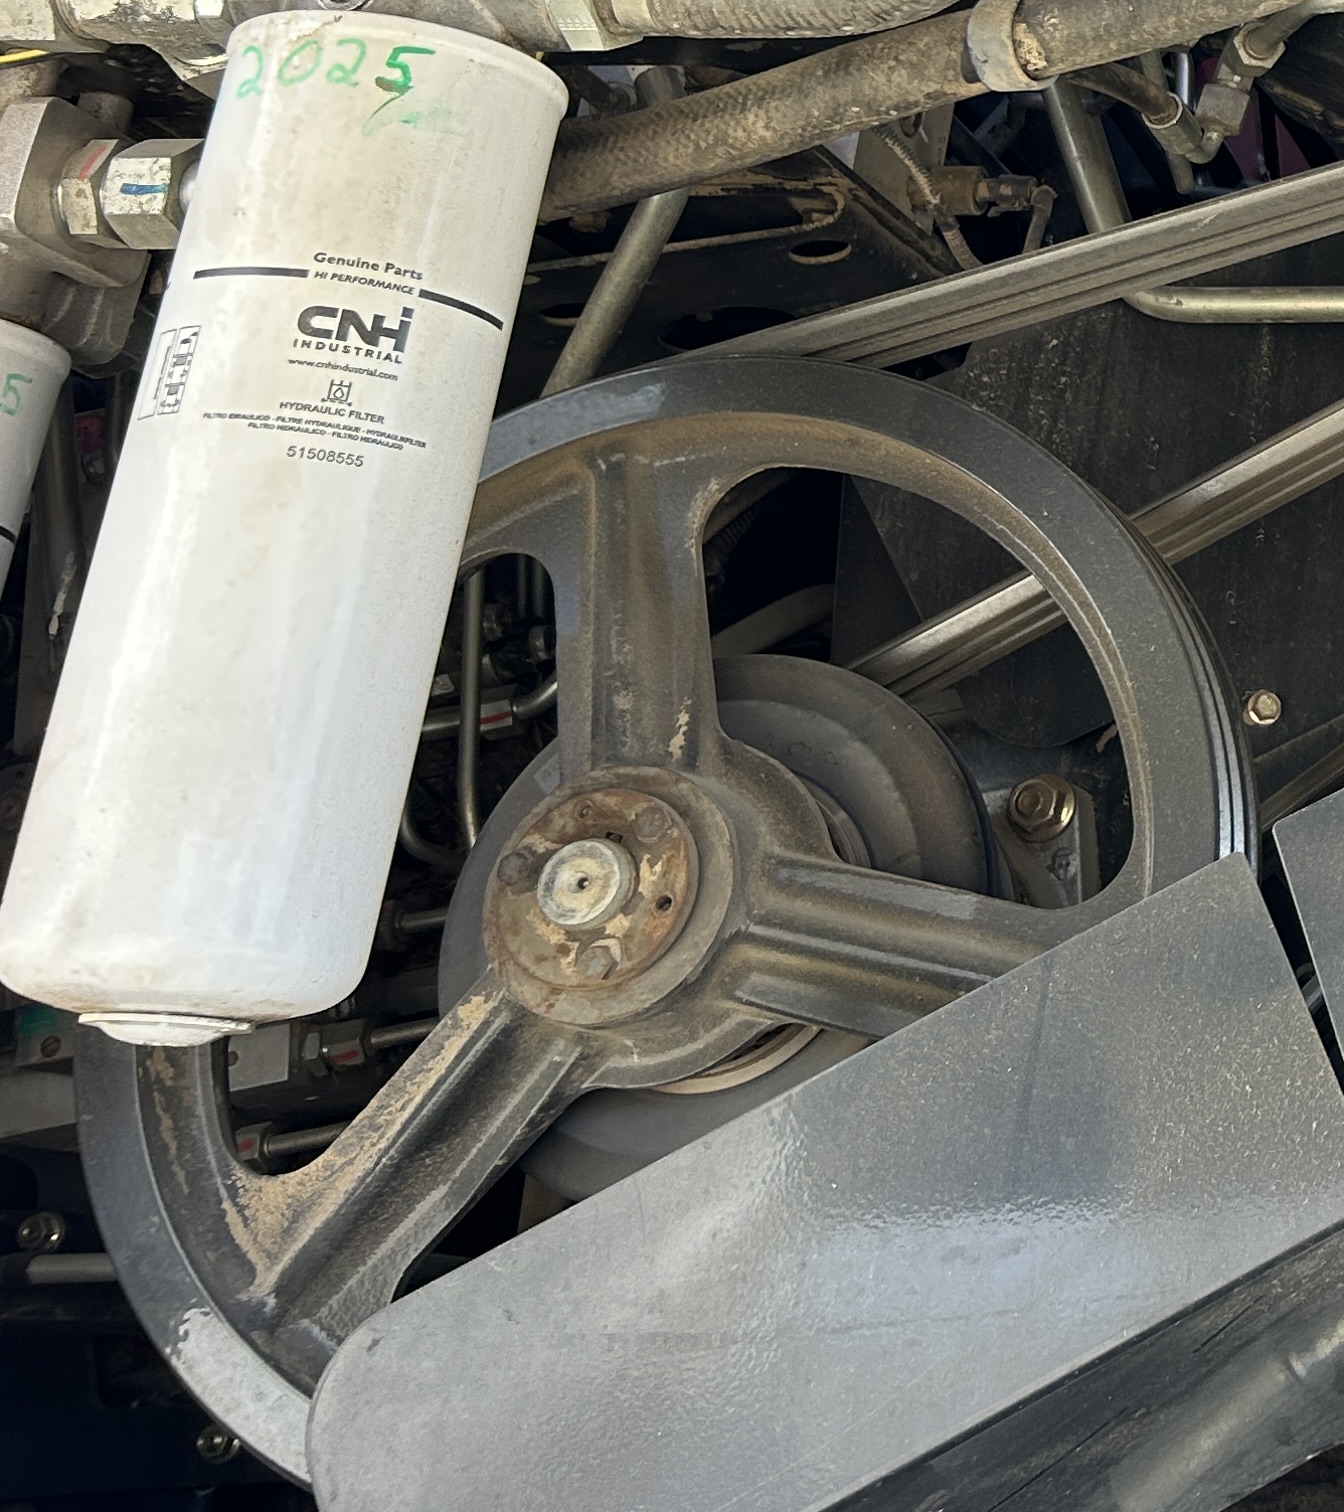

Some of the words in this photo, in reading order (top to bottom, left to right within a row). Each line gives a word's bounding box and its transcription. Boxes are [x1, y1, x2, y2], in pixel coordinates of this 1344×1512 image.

[236, 38, 436, 99] 2025
[313, 251, 380, 272] Genuine
[384, 262, 423, 281] Parts
[314, 271, 329, 281] HI
[330, 272, 415, 295] PERFORMANCE
[293, 338, 403, 364] INDUSTRIAL
[287, 359, 398, 381] www.cnhindustrial.com
[279, 401, 347, 418] HYDRAULIC
[347, 408, 386, 425] FILTER
[287, 445, 365, 468] 51508555
